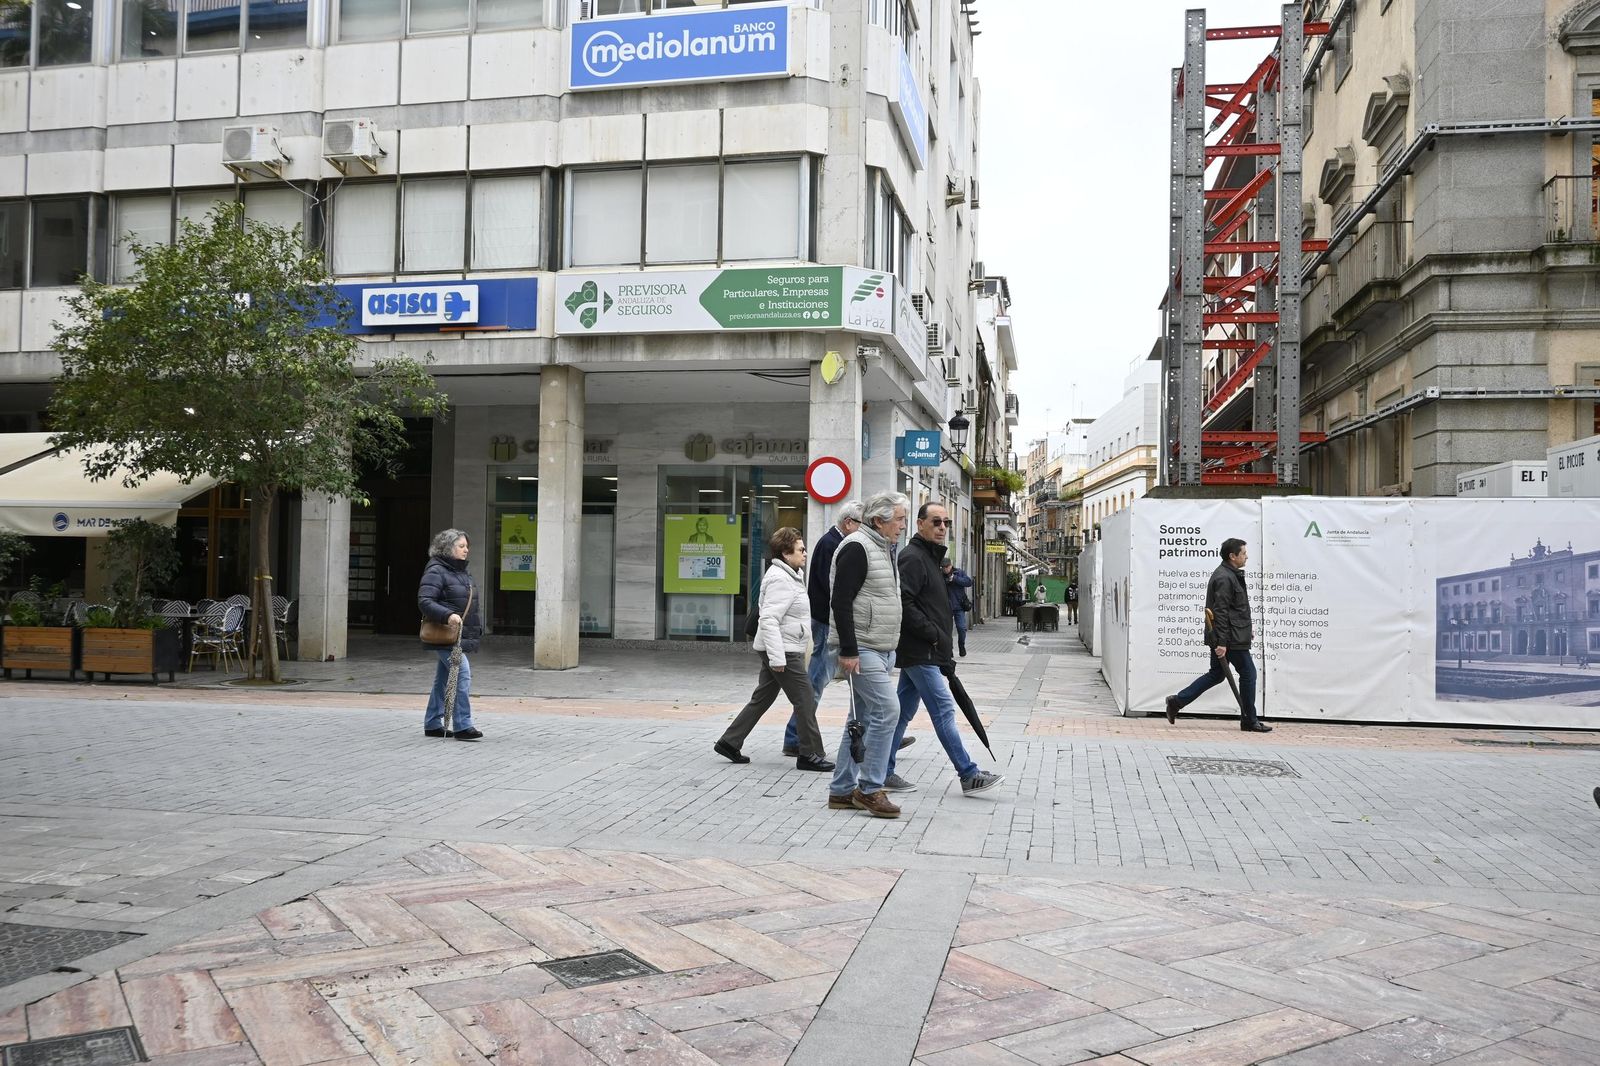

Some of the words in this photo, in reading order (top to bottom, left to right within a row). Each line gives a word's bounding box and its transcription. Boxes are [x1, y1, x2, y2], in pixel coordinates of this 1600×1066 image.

[733, 21, 776, 33] BANCO
[591, 29, 776, 64] mediolanum
[767, 275, 806, 286] Seguros
[808, 275, 830, 286] para
[618, 283, 687, 297] PREVISORA
[723, 288, 780, 299] Particulares,
[782, 287, 829, 298] Empresas
[368, 292, 438, 315] asisa
[617, 297, 655, 305] ANDALUZA
[656, 296, 667, 304] DE
[759, 302, 766, 310] e
[768, 300, 829, 310] Instituciones
[617, 304, 673, 316] SEGUROS
[729, 311, 802, 321] previsoraandaluza.es
[848, 314, 861, 326] La
[865, 313, 887, 329] Paz
[768, 455, 788, 464] CAJA
[907, 450, 937, 459] cajamar
[1558, 456, 1566, 470] EL
[1521, 471, 1535, 482] EL
[77, 517, 96, 527] MAR
[1159, 524, 1201, 535] Somos
[1159, 536, 1208, 546] nuestro
[522, 554, 533, 562] 500
[1159, 547, 1222, 560] patrimoni
[706, 556, 721, 566] 500
[1158, 569, 1188, 578] Huelva
[1276, 572, 1320, 580] milenaria.
[1158, 580, 1178, 590] Bajo
[1179, 581, 1187, 589] el
[1189, 581, 1208, 590] suel
[1270, 583, 1285, 592] del
[1304, 584, 1313, 592] el
[1158, 592, 1205, 601] patrimonio
[1266, 595, 1297, 604] amplio
[1298, 596, 1304, 604] y
[1157, 603, 1192, 612] diverso.
[1288, 606, 1297, 615] la
[1298, 607, 1329, 616] ciudad
[1177, 616, 1206, 626] antigu
[1273, 620, 1278, 628] y
[1280, 618, 1297, 628] hoy
[1157, 626, 1166, 634] el
[1167, 626, 1196, 637] reflejo
[1265, 629, 1288, 638] hace
[1289, 630, 1309, 639] más
[1310, 631, 1322, 639] de
[1157, 637, 1183, 646] 2.500
[1305, 642, 1322, 652] hoy
